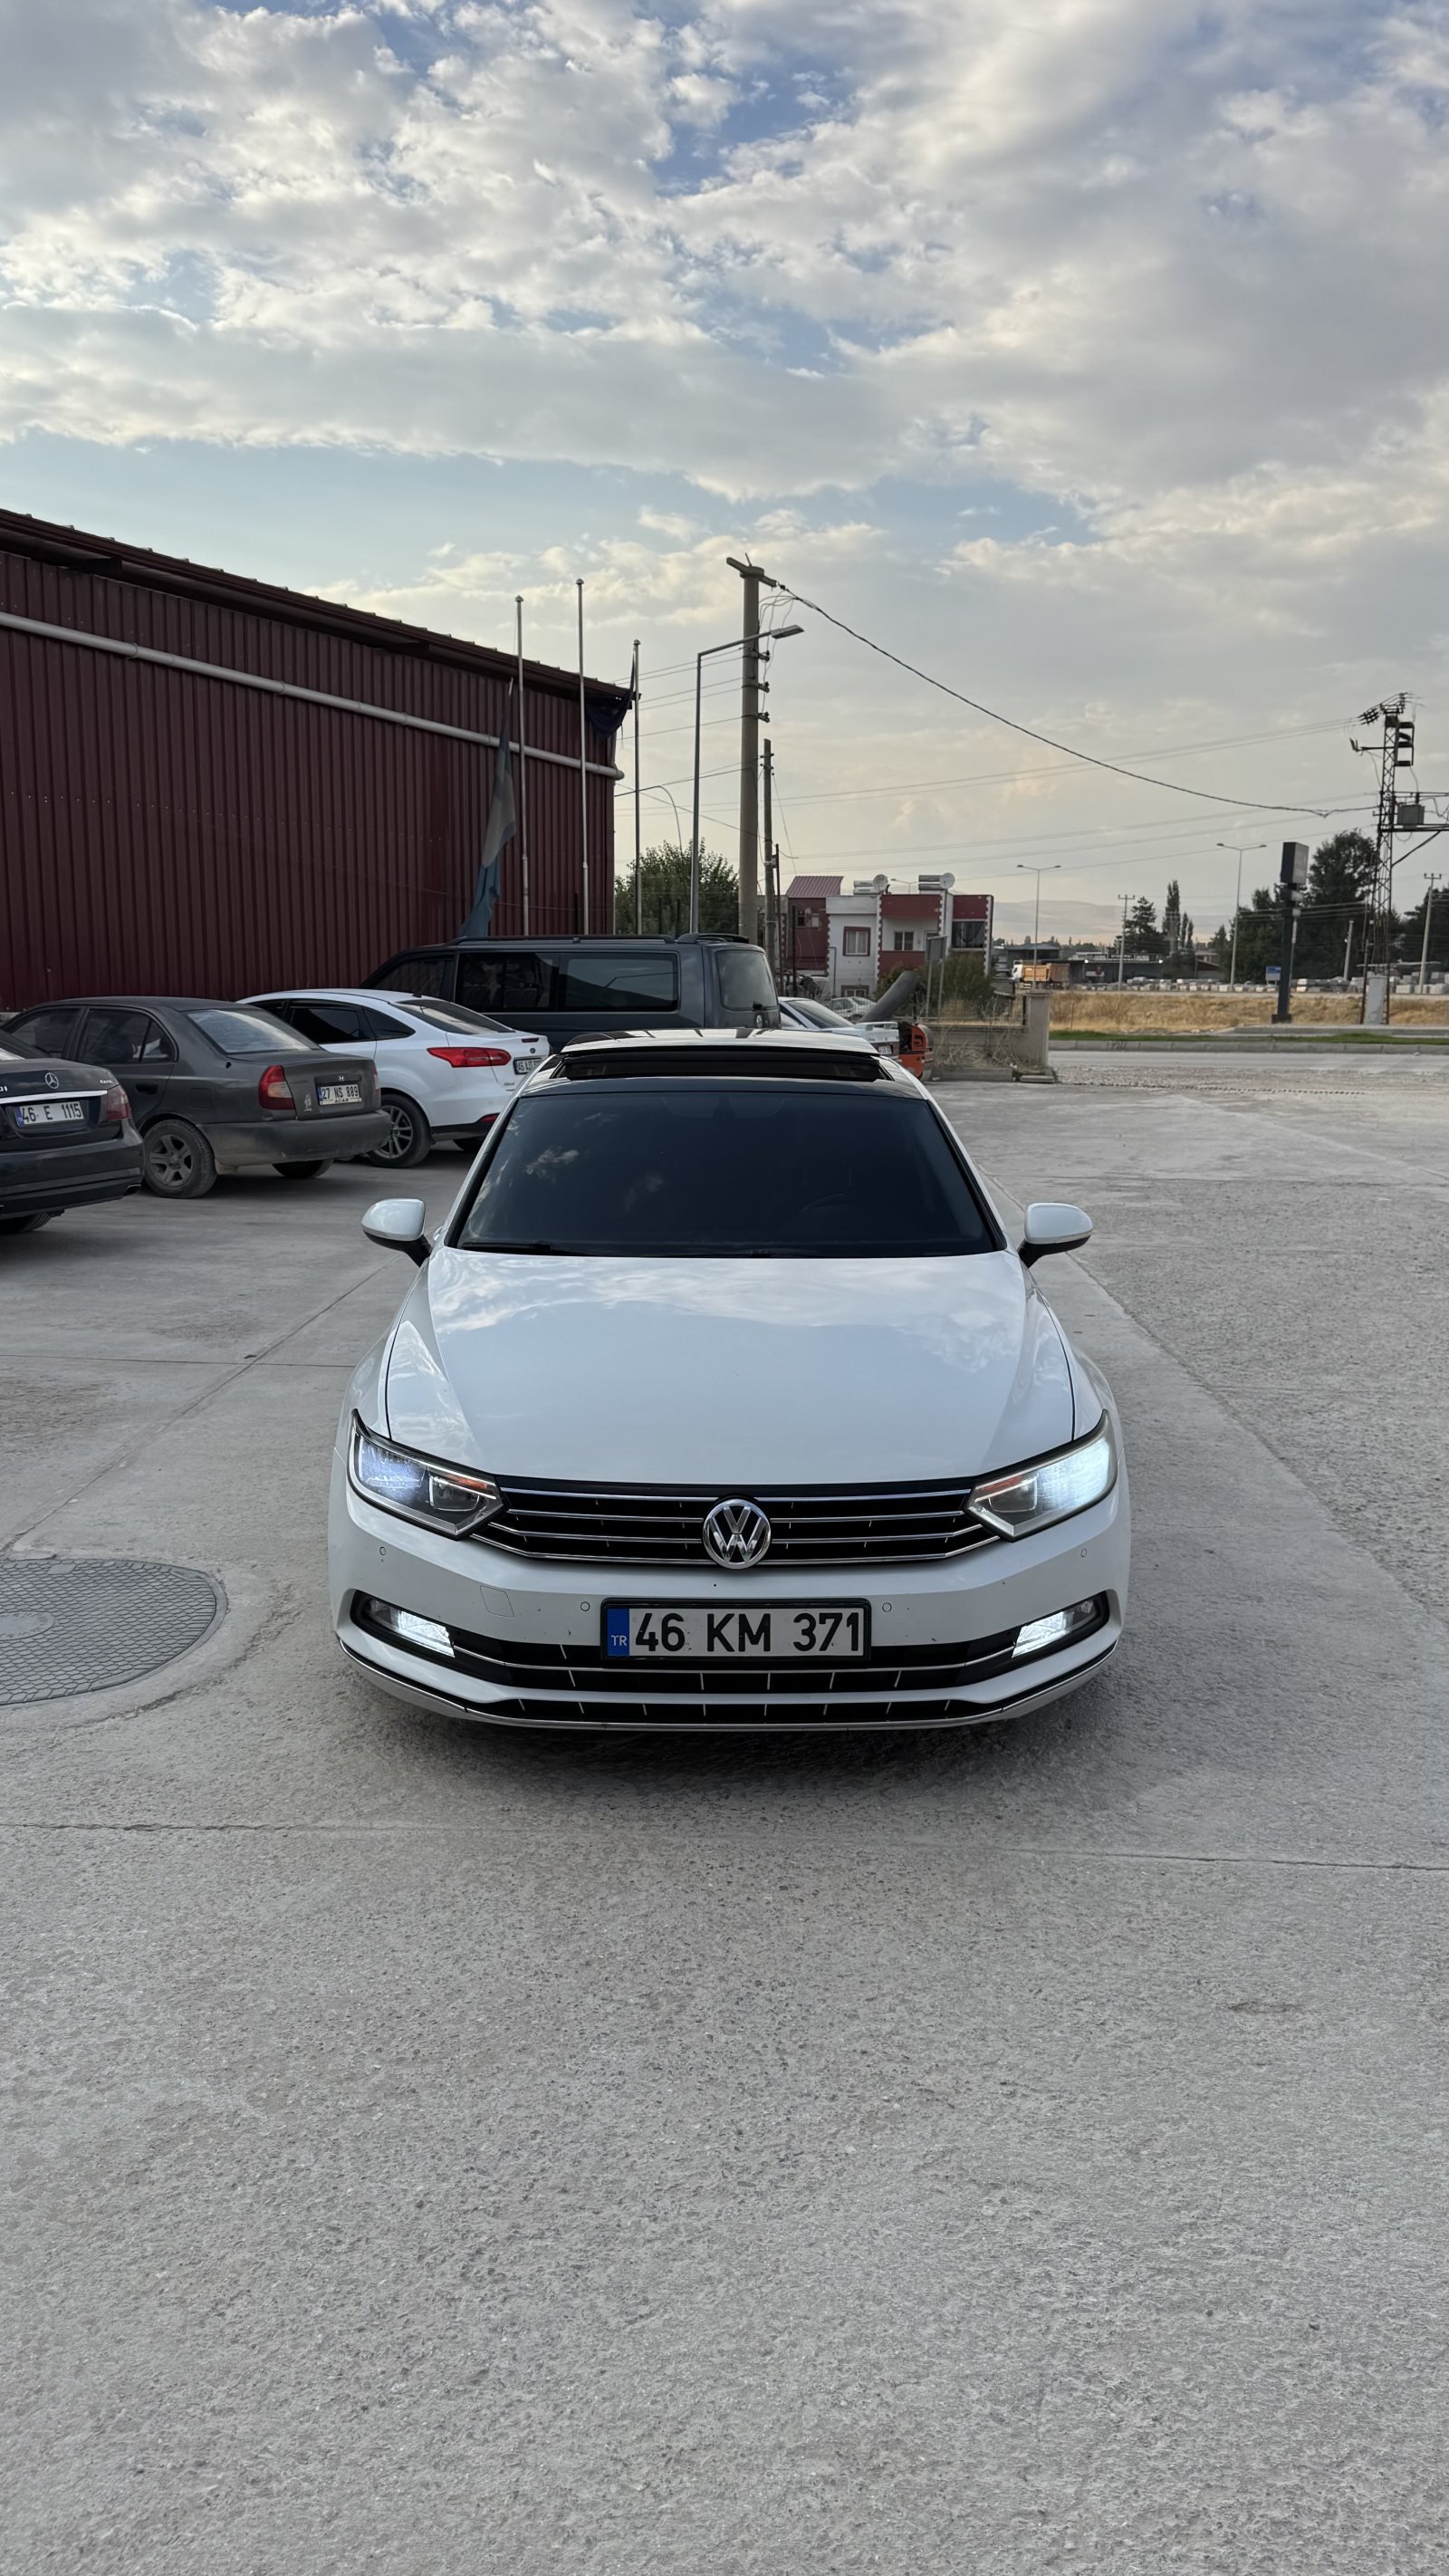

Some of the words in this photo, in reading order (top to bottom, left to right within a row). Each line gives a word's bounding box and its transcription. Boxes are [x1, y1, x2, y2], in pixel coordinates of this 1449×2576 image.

[321, 1088, 331, 1100] 27
[333, 1087, 343, 1098] NS
[346, 1085, 359, 1097] 889
[22, 1107, 36, 1122] 46
[43, 1105, 53, 1120] E
[61, 1103, 82, 1119] 1115
[705, 1504, 768, 1565] VW
[611, 1635, 627, 1646] TR
[635, 1612, 686, 1652] 46
[706, 1612, 771, 1653] KM
[792, 1611, 859, 1652] 371
